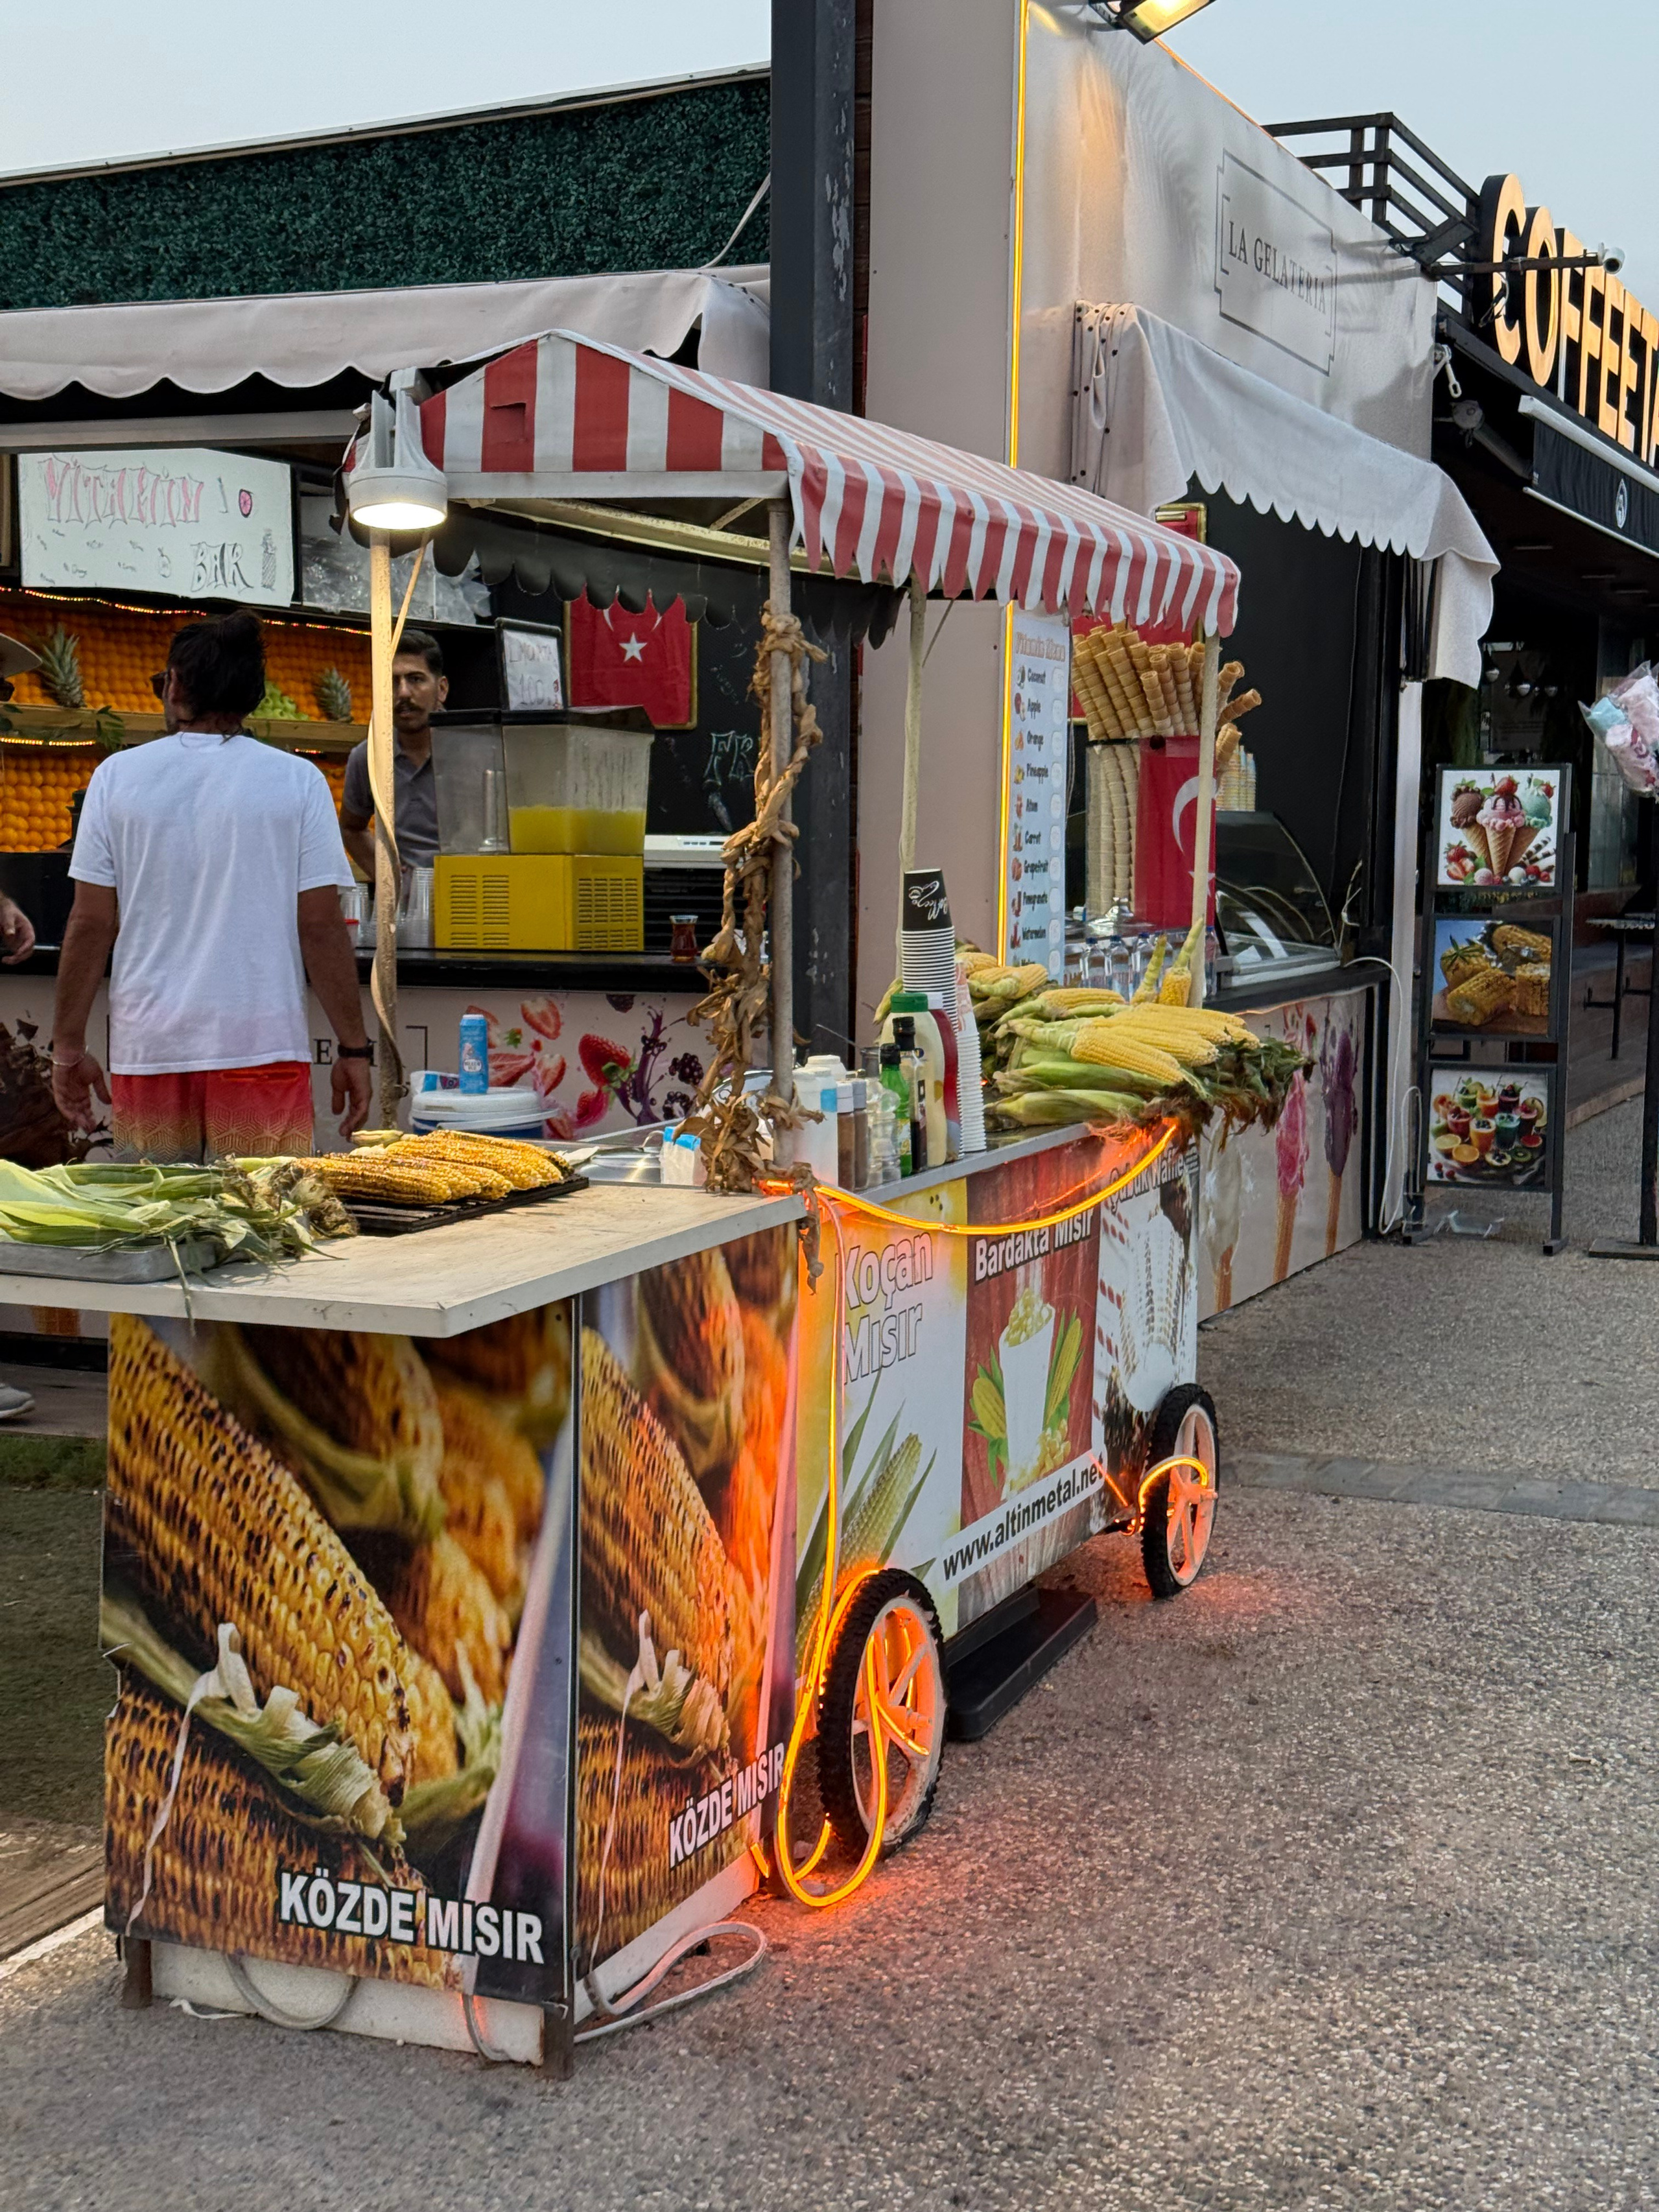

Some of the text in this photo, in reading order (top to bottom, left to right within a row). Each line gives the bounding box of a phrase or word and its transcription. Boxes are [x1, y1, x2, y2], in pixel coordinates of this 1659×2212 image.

[1229, 220, 1326, 314] LA GELATERIA
[191, 541, 253, 593] BAR
[835, 1232, 934, 1311] Koçan
[974, 1227, 1050, 1283] Bardakta
[843, 1303, 923, 1385] Mısır
[943, 1452, 1103, 1581] www.altinmetal.net
[669, 1742, 785, 1869] KÖZDE MISIR
[280, 1866, 546, 1964] KÖZDE MISIR
